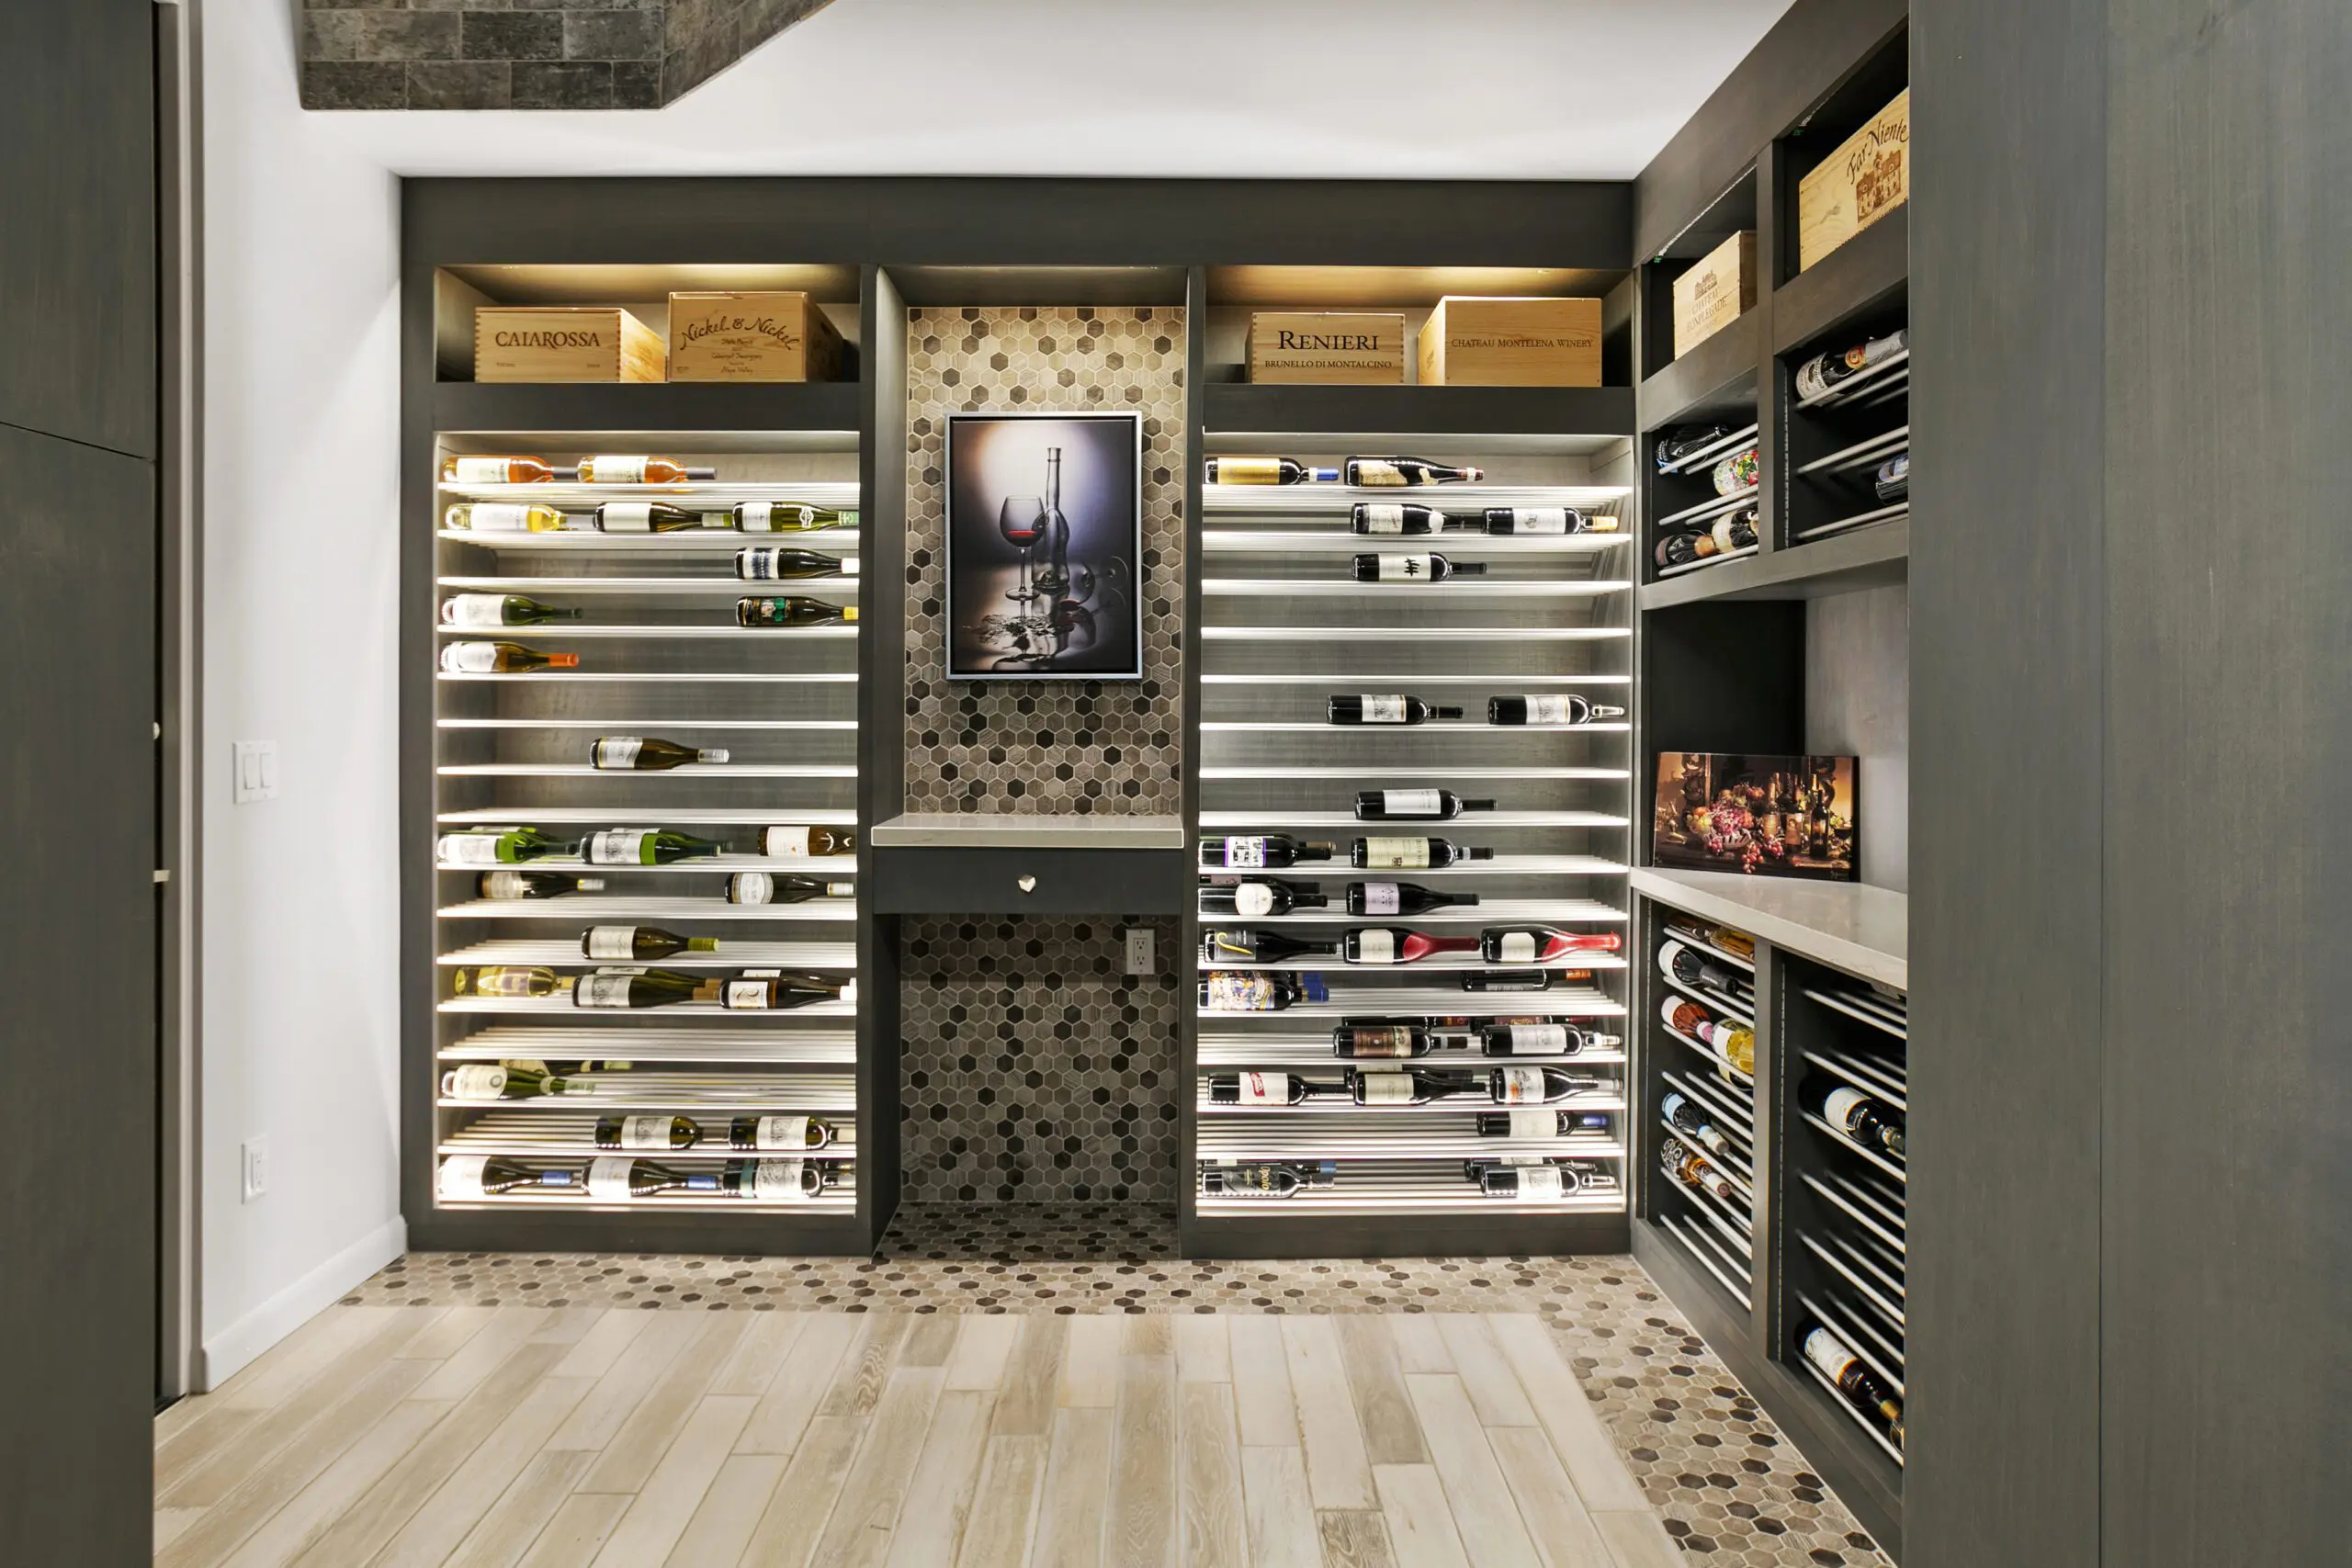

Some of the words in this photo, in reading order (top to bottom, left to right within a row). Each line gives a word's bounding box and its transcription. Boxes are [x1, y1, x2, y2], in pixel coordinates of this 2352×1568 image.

[1847, 143, 1868, 186] Far
[1867, 118, 1909, 156] Niente
[495, 331, 601, 350] CAIAROSSA
[680, 316, 729, 350] Nickel
[732, 318, 745, 330] &
[744, 317, 800, 351] Nickel
[1277, 330, 1379, 350] RENIERI
[1451, 338, 1495, 348] CHATEAU
[1498, 338, 1555, 348] MONTELENA
[1556, 338, 1594, 348] WINERY
[1265, 360, 1314, 368] BRUNELLO
[1316, 360, 1327, 368] DI
[1328, 360, 1392, 368] MONTALCINO
